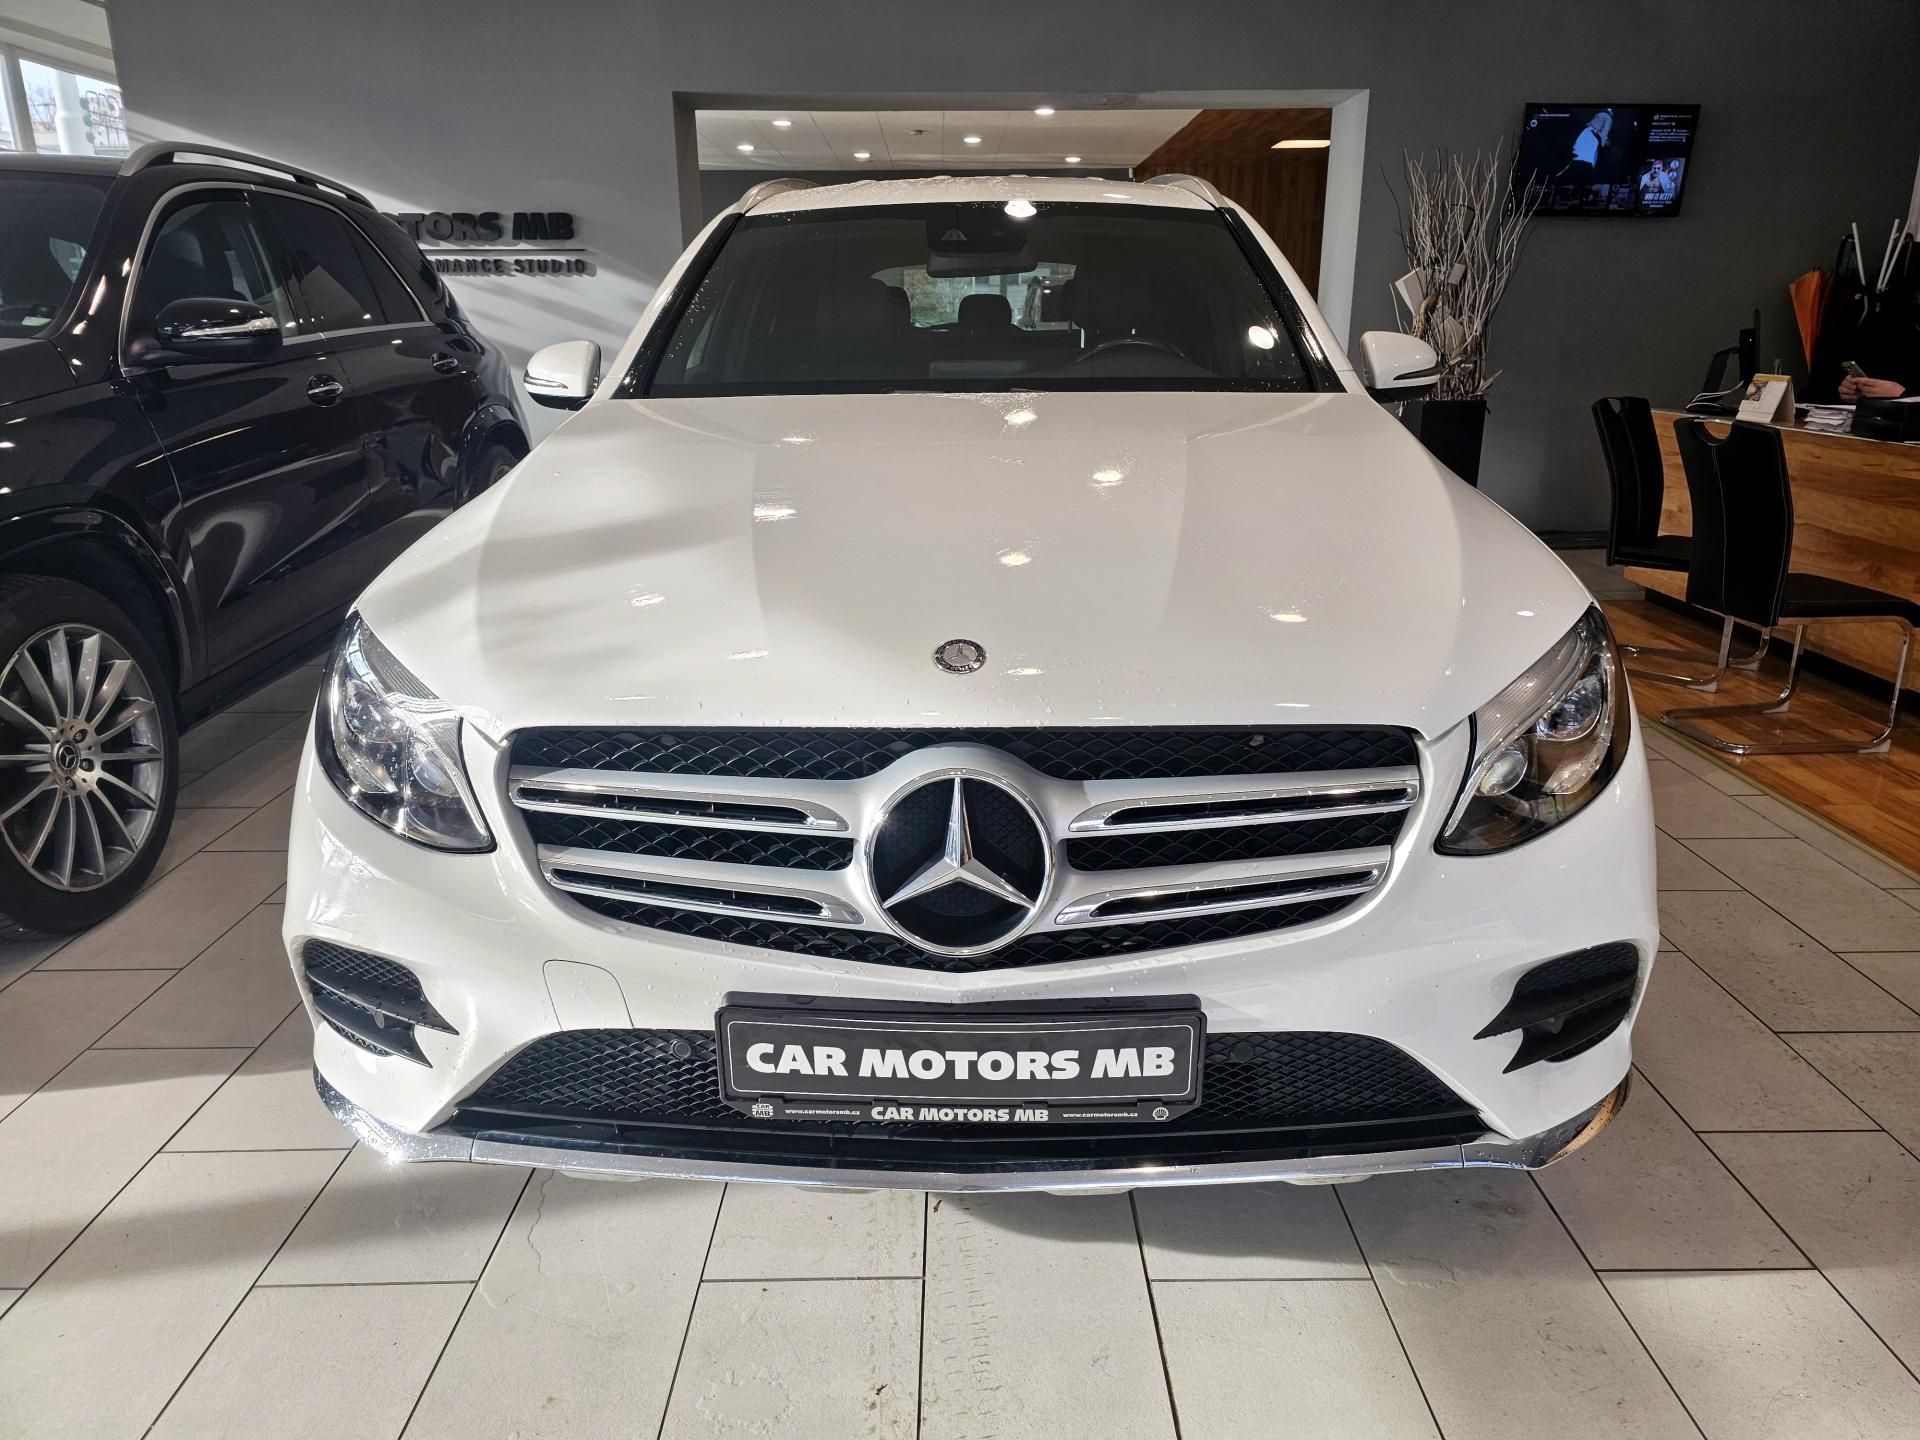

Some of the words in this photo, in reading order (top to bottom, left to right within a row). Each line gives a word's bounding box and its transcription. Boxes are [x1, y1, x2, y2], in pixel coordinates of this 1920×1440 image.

[382, 212, 503, 241] TORS
[512, 212, 575, 241] MB
[433, 258, 505, 274] MANCE
[514, 258, 586, 274] STUDIO
[746, 1042, 849, 1076] CAR
[858, 1048, 1080, 1080] MOTORS
[1090, 1046, 1175, 1078] MB
[871, 1107, 914, 1120] CAR
[918, 1107, 1010, 1121] MOTORS
[1013, 1109, 1048, 1121] MB
